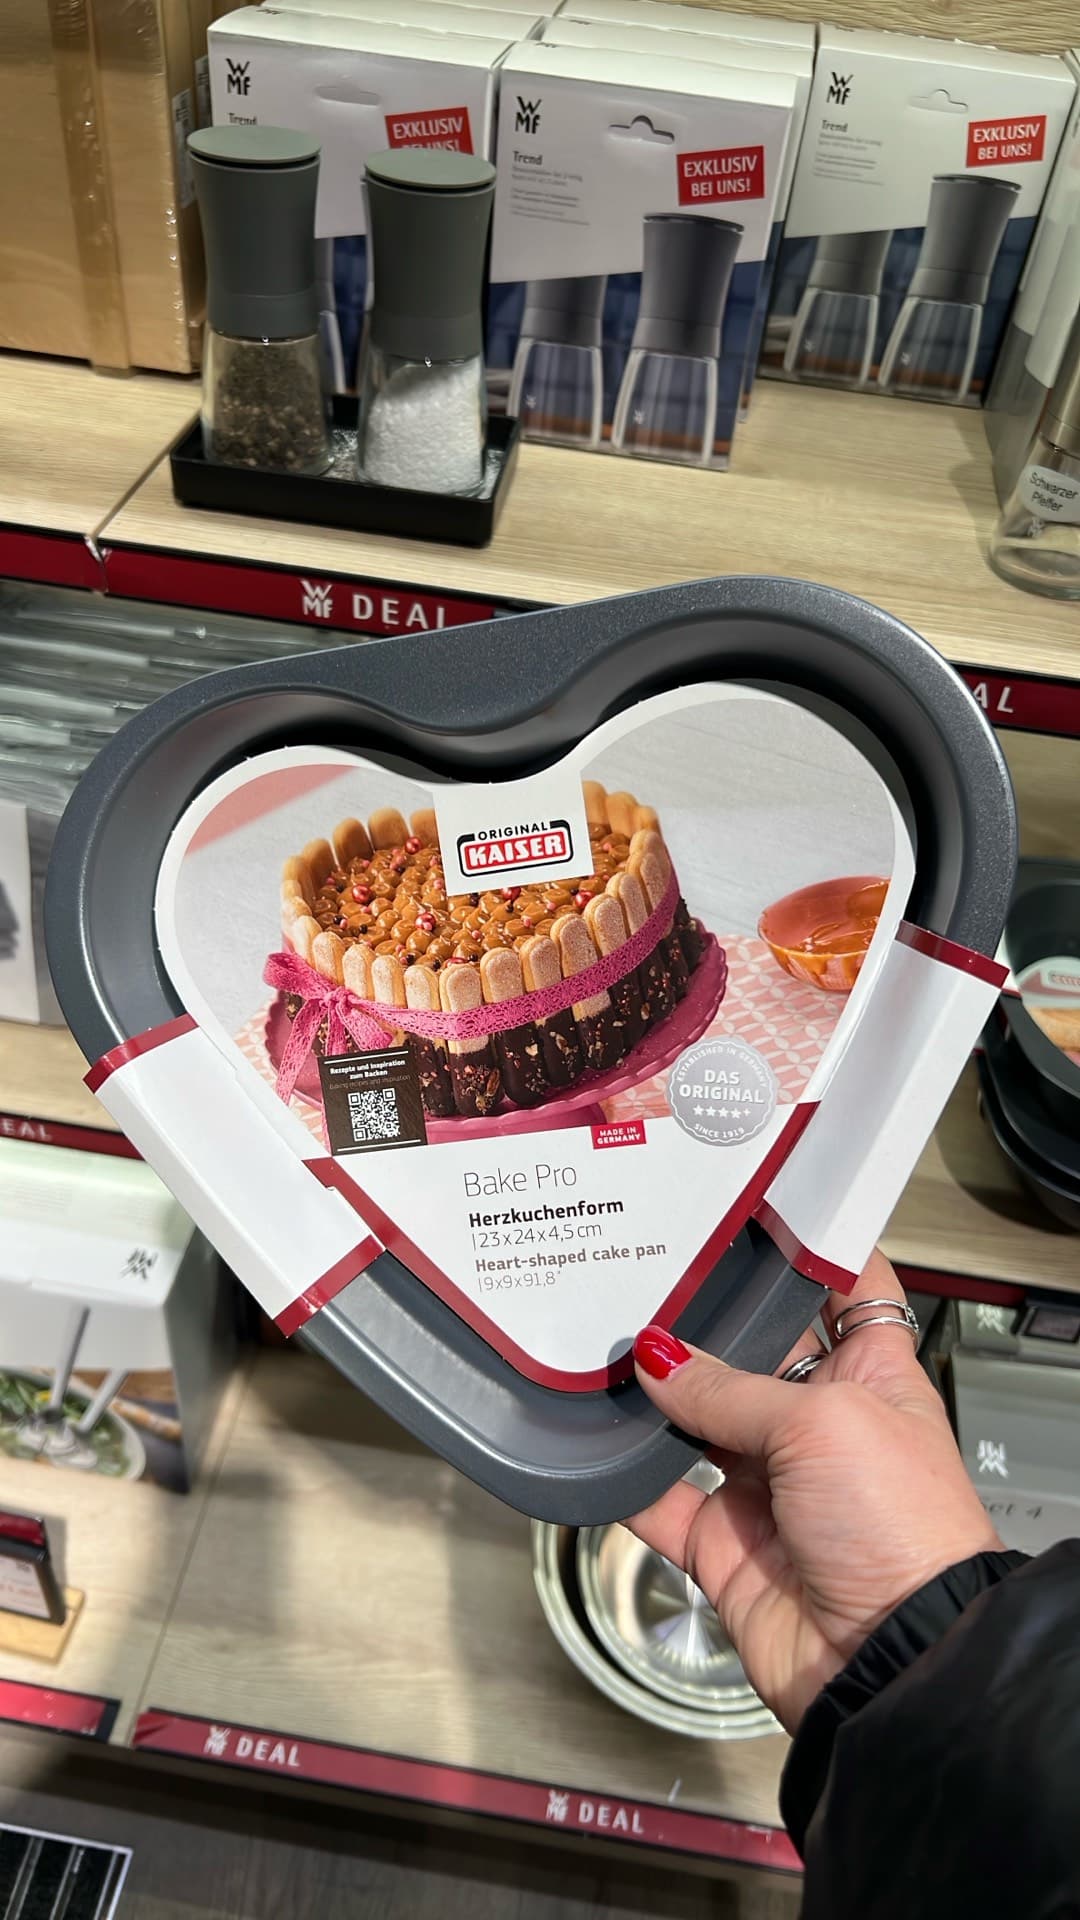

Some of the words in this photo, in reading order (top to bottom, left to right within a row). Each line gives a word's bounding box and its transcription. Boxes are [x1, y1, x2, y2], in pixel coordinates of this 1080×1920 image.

[392, 116, 464, 140] EXKLUSIV
[822, 119, 849, 134] Trend
[972, 122, 1041, 144] EXKLUSIV
[512, 150, 543, 166] Trend
[977, 147, 998, 161] BEI
[1001, 143, 1032, 159] UNS!
[683, 154, 758, 178] EXKLUSIV
[691, 182, 713, 198] BEI
[716, 177, 752, 196] UNS!
[1030, 471, 1079, 500] Schwarzer
[973, 682, 1014, 713] AL
[477, 821, 549, 842] ORIGINAL
[467, 834, 564, 868] KAISER
[676, 1046, 724, 1082] ESTABLISHED
[703, 1069, 741, 1085] DAS
[679, 1084, 766, 1105] ORIGINAL
[0, 1118, 52, 1142] EAL
[597, 1133, 641, 1145] GERMANY
[600, 1127, 624, 1137] MADE
[626, 1126, 637, 1134] IN
[693, 1122, 720, 1139] SINCE
[722, 1127, 746, 1139] 1919
[463, 1167, 528, 1198] Bake
[535, 1163, 578, 1190] Pro
[469, 1200, 625, 1228] Herzkuchenform
[475, 1248, 588, 1273] Heart-shaped
[592, 1245, 631, 1262] cake
[636, 1243, 667, 1260] pan
[235, 1736, 301, 1767] DEAL
[578, 1799, 645, 1835] DEAL
